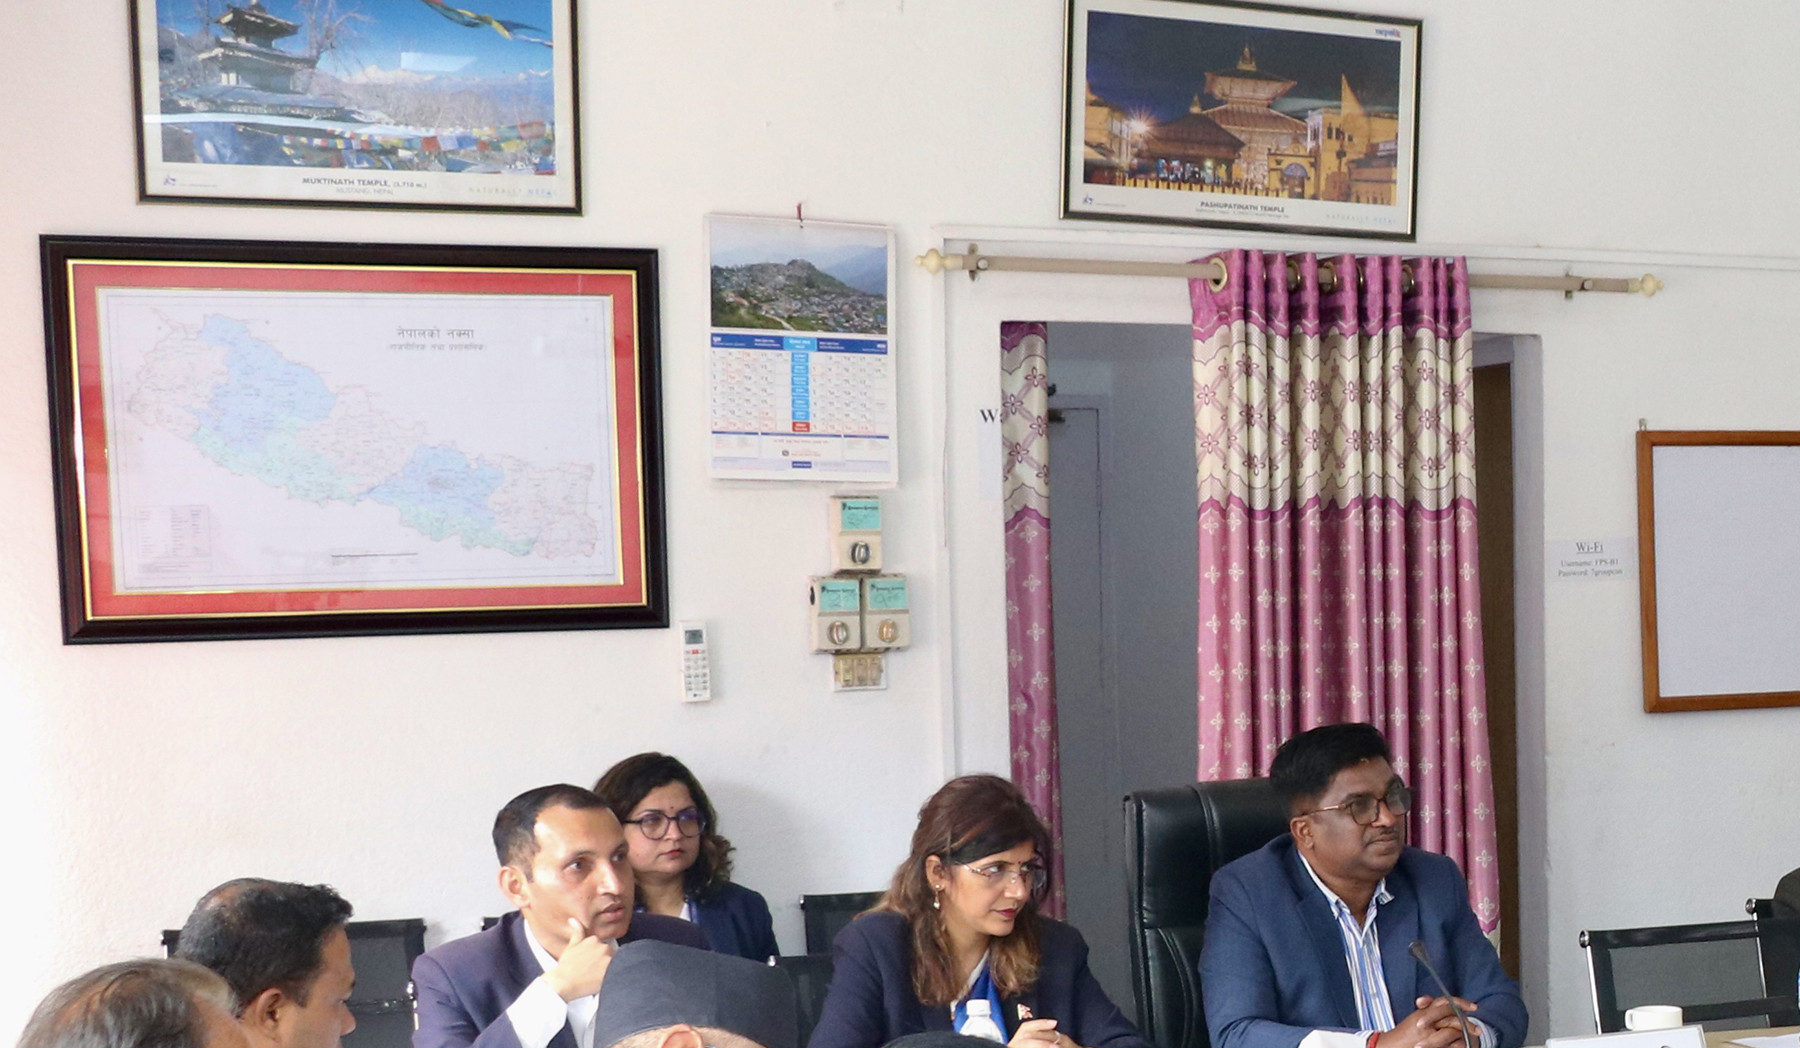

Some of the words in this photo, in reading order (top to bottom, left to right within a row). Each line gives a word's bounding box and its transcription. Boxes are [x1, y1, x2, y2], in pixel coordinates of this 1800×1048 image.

[302, 177, 355, 186] MUKTINATH
[357, 179, 391, 188] TEMPLE,
[1200, 201, 1258, 211] PASHUPATINATH
[1260, 205, 1285, 213] TEMPLE
[396, 326, 441, 339] नेपालको
[1576, 542, 1603, 553] Wi-Fi
